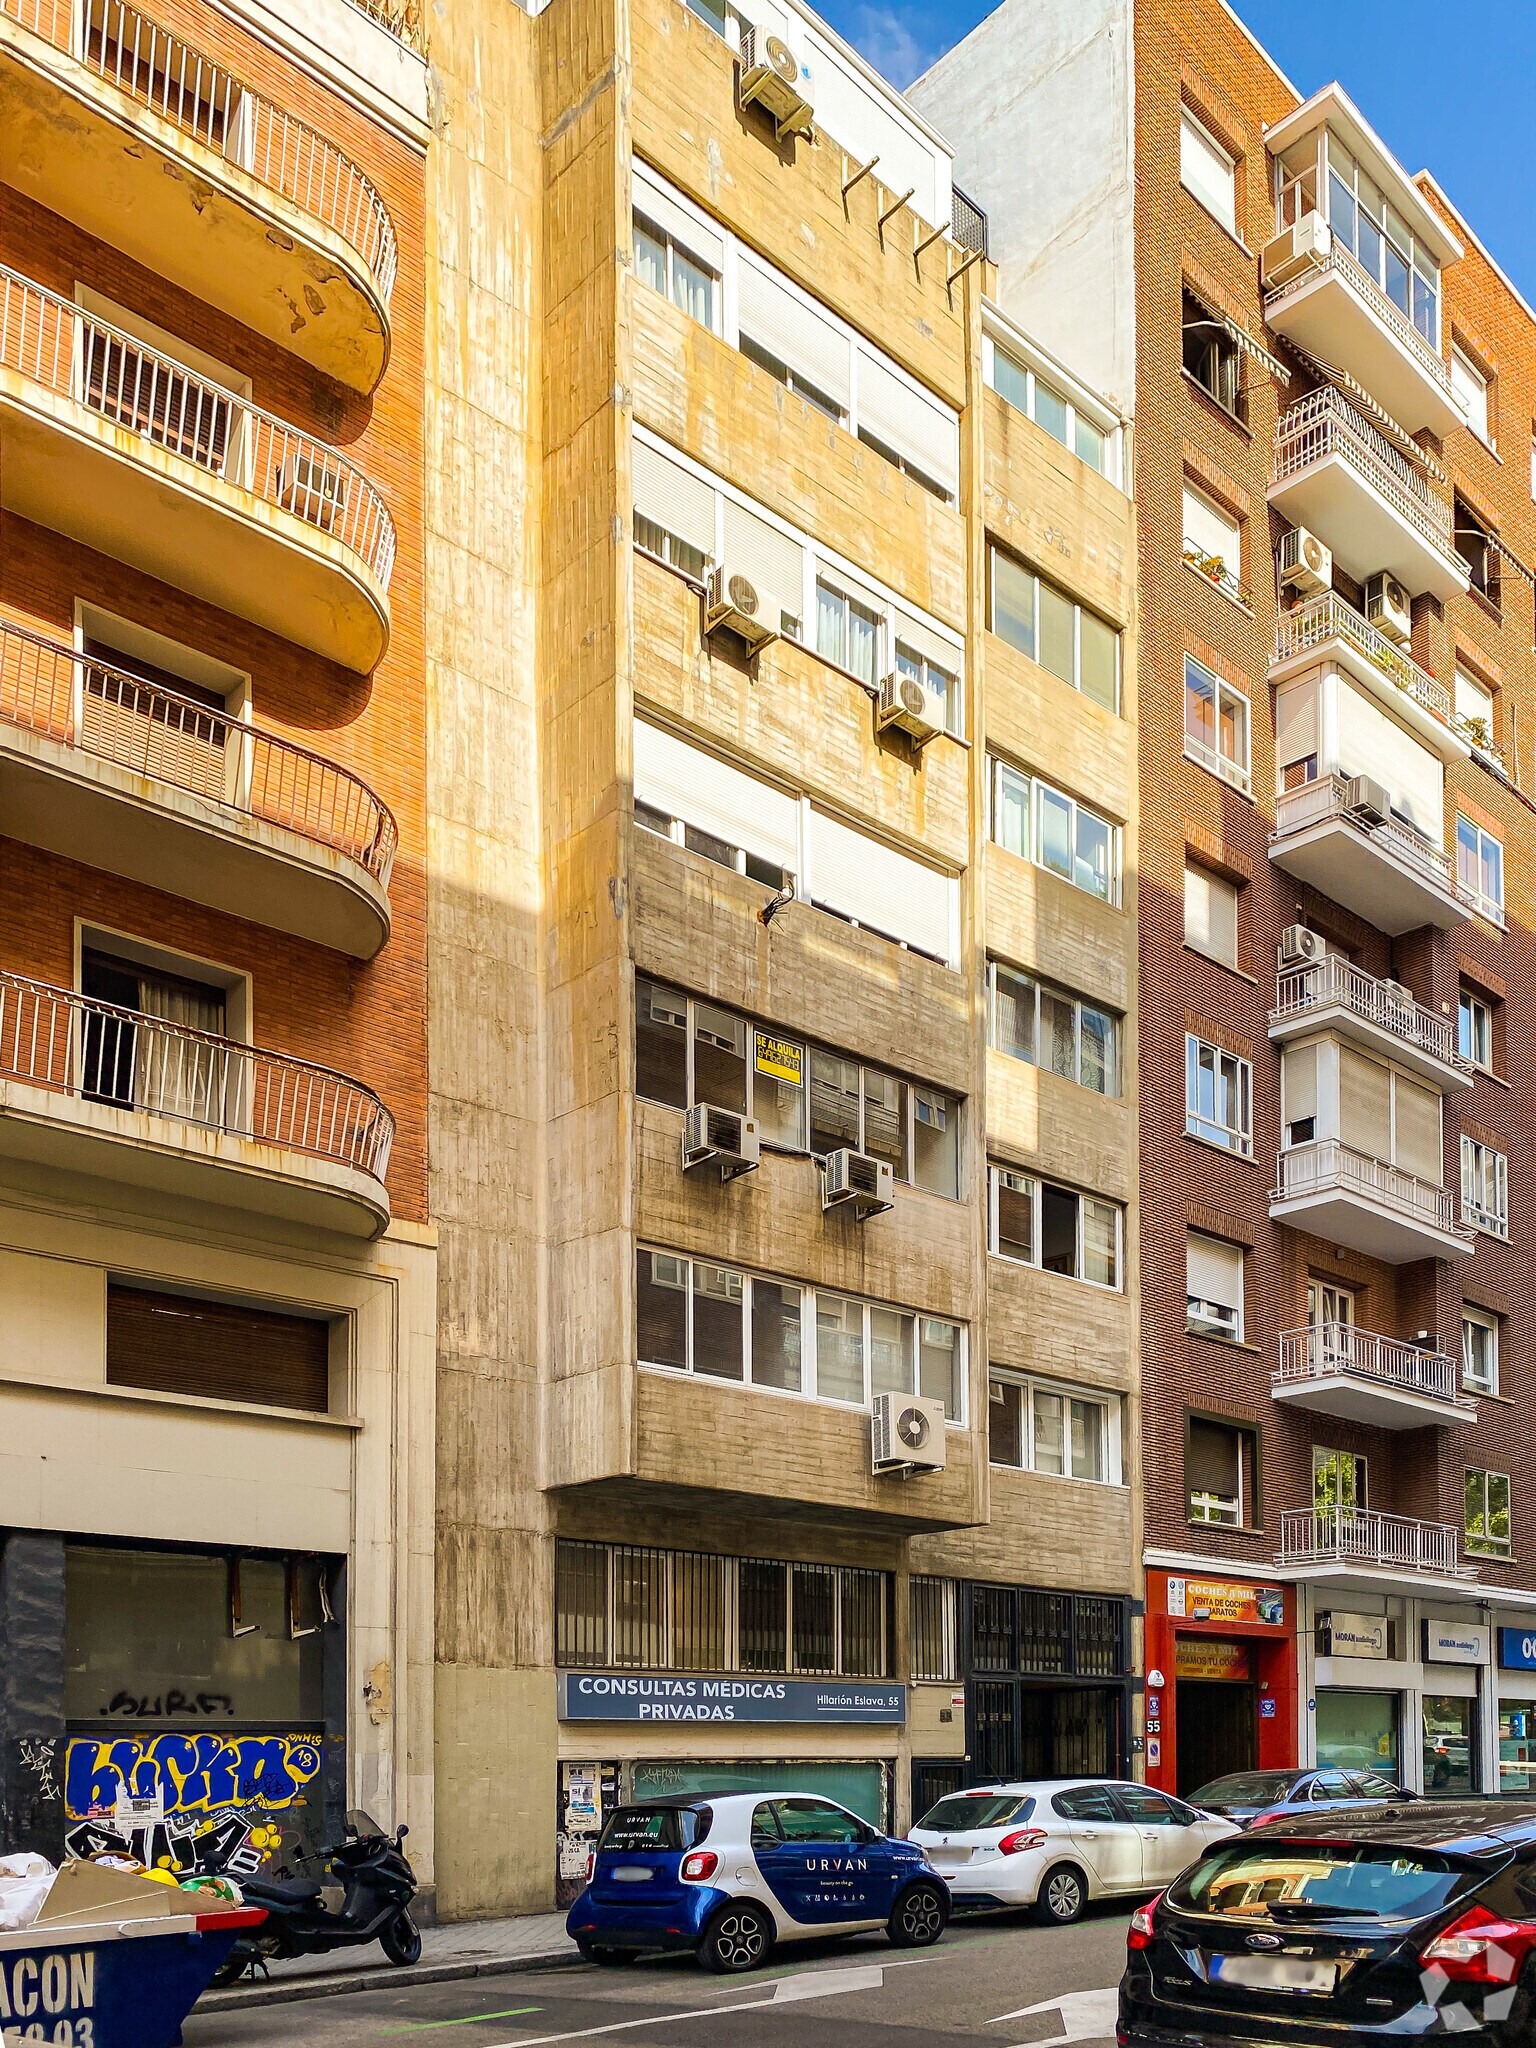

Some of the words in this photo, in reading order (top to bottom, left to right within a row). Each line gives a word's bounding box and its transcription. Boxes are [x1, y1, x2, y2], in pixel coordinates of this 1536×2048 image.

[757, 1035, 766, 1047] SE
[767, 1040, 800, 1060] ALQUILA
[1188, 1585, 1227, 1597] COCHES
[1229, 1588, 1236, 1600] A
[1237, 1589, 1256, 1601] MIL
[1192, 1597, 1213, 1607] VENTA
[1214, 1598, 1224, 1608] DE
[1224, 1599, 1251, 1611] COCHES
[1209, 1607, 1238, 1617] BARATOS
[1209, 1657, 1218, 1667] TU
[578, 1677, 697, 1698] CONSULTAS
[702, 1680, 786, 1699] MÉDICAS
[854, 1695, 886, 1707] Eslava,
[888, 1696, 899, 1706] 55
[638, 1703, 736, 1720] PRIVADAS
[1147, 1720, 1161, 1733] 55
[614, 1831, 659, 1839] www.urvan.eu
[806, 1858, 867, 1872] URVAN
